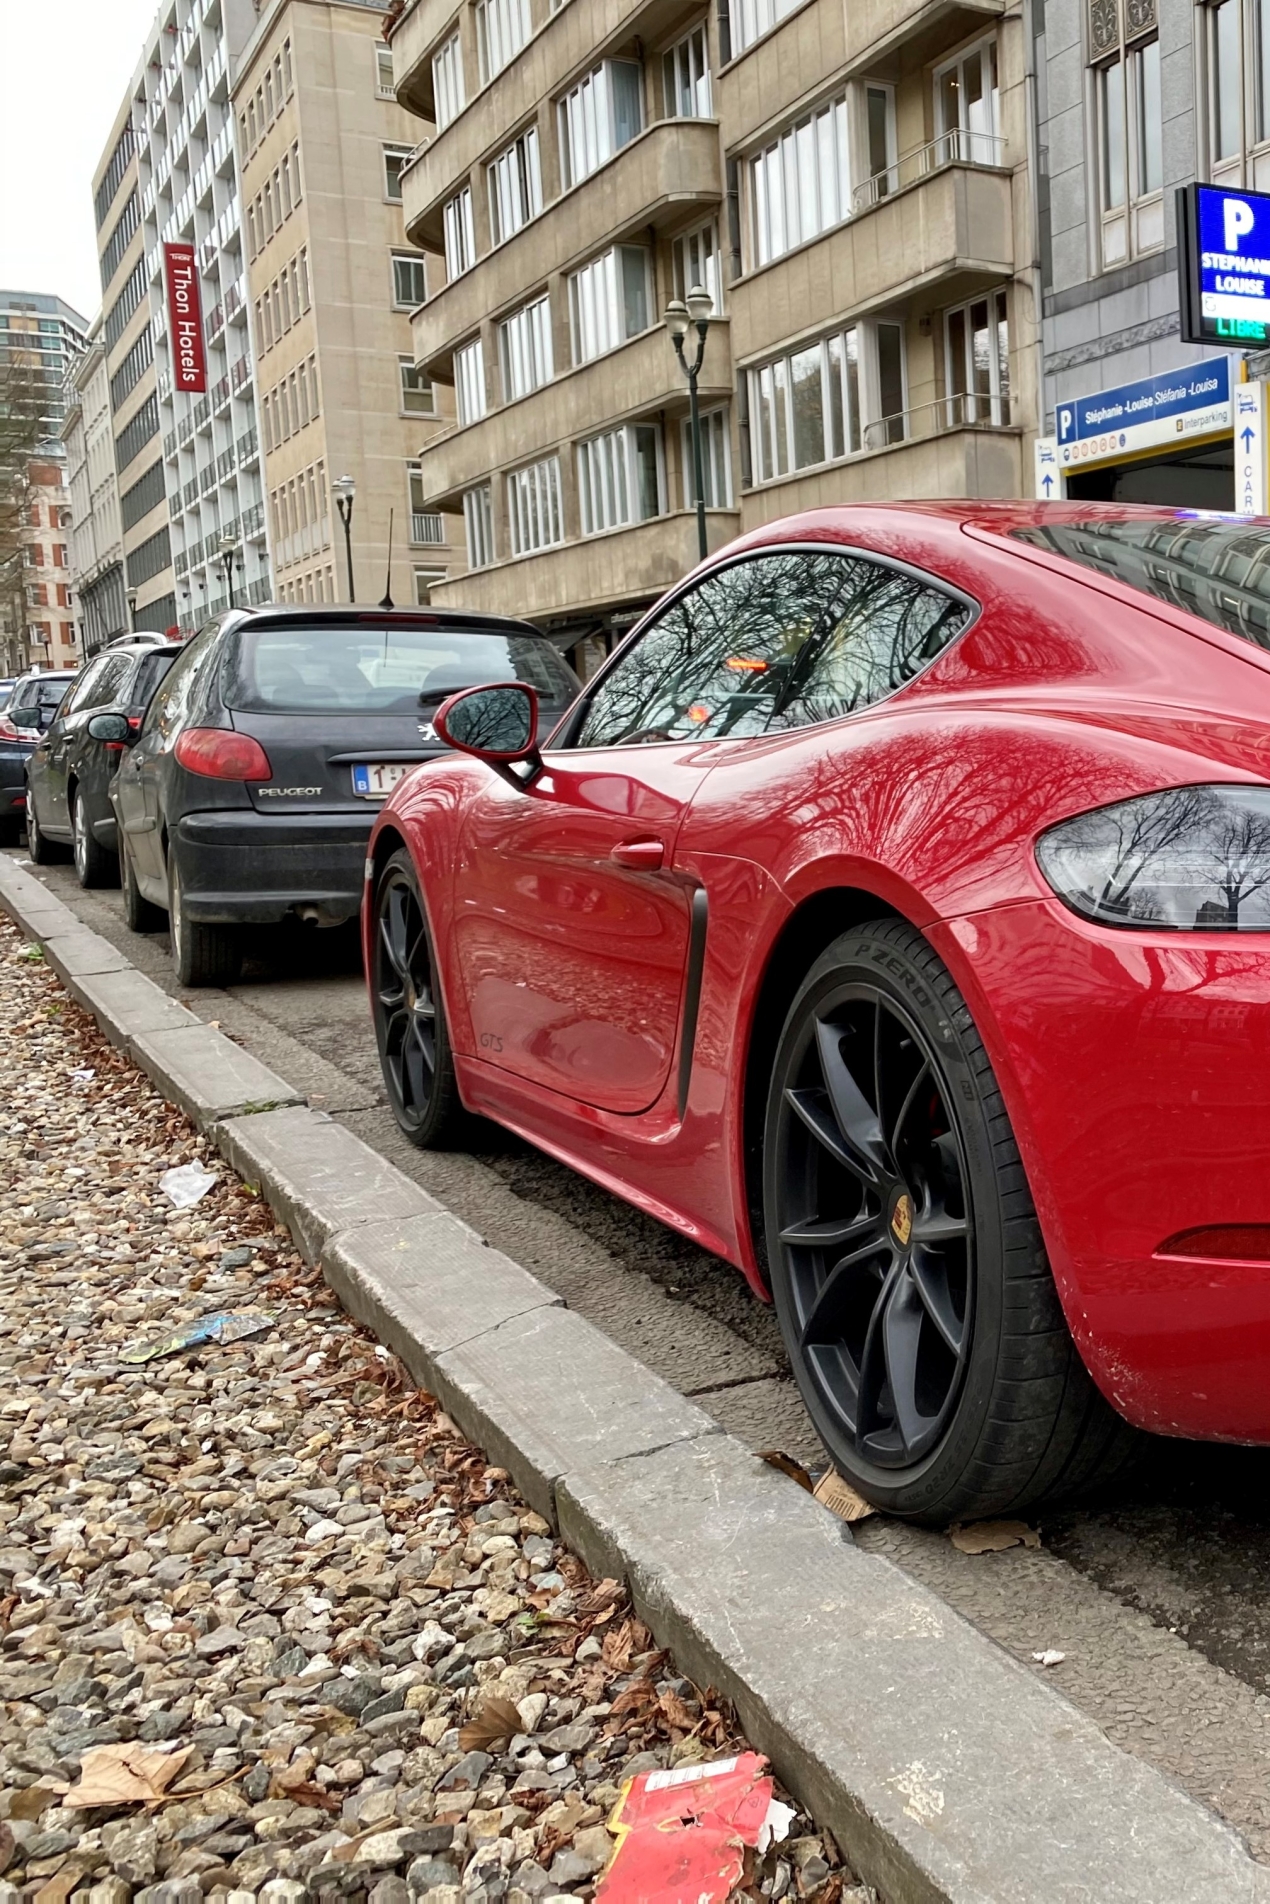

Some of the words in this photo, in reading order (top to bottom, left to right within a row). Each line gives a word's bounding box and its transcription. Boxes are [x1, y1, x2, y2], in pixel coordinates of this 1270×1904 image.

[1223, 198, 1254, 251] P
[174, 266, 192, 313] Thon
[1215, 275, 1265, 295] LOUISE
[1216, 317, 1266, 338] LIBRE
[178, 321, 199, 382] Hotels
[1085, 403, 1123, 425] Stéphanie
[1154, 386, 1187, 406] Stéfania
[1184, 410, 1228, 430] Interparking
[1060, 409, 1072, 440] P
[1243, 465, 1255, 514] CAR
[258, 786, 323, 797] PEUGEOT
[357, 780, 367, 791] B
[871, 948, 931, 1009] ZERO
[480, 1032, 504, 1053] GTS
